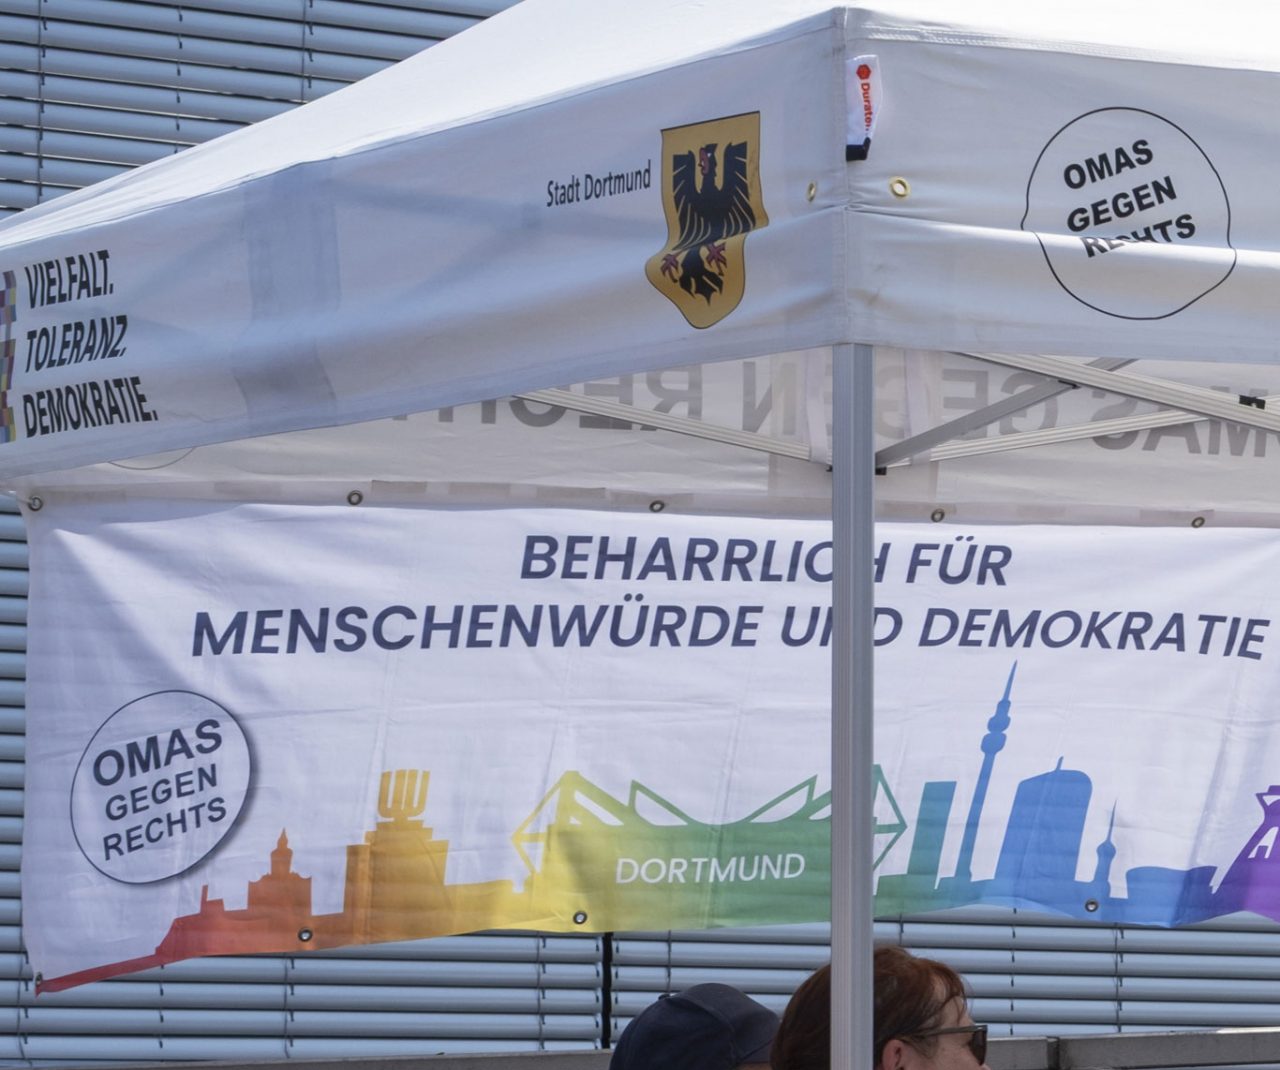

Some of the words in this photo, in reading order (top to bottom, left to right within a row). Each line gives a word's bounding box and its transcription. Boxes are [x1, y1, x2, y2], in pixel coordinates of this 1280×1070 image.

[546, 174, 580, 207] Stadt
[584, 159, 651, 200] Dortmund
[1063, 139, 1154, 190] OMAS
[1067, 175, 1177, 232] GEGEN
[24, 250, 114, 309] VIELFALT.
[23, 376, 158, 438] DEMOKRATIE.
[905, 535, 1012, 586] FÜR
[191, 593, 764, 657] MENSCHENWÜRDE
[918, 607, 1271, 660] DEMOKRATIE
[93, 719, 222, 786] OMAS
[105, 763, 217, 821] GEGEN
[103, 797, 227, 861] RECHTS
[615, 853, 806, 884] DORTMUND
